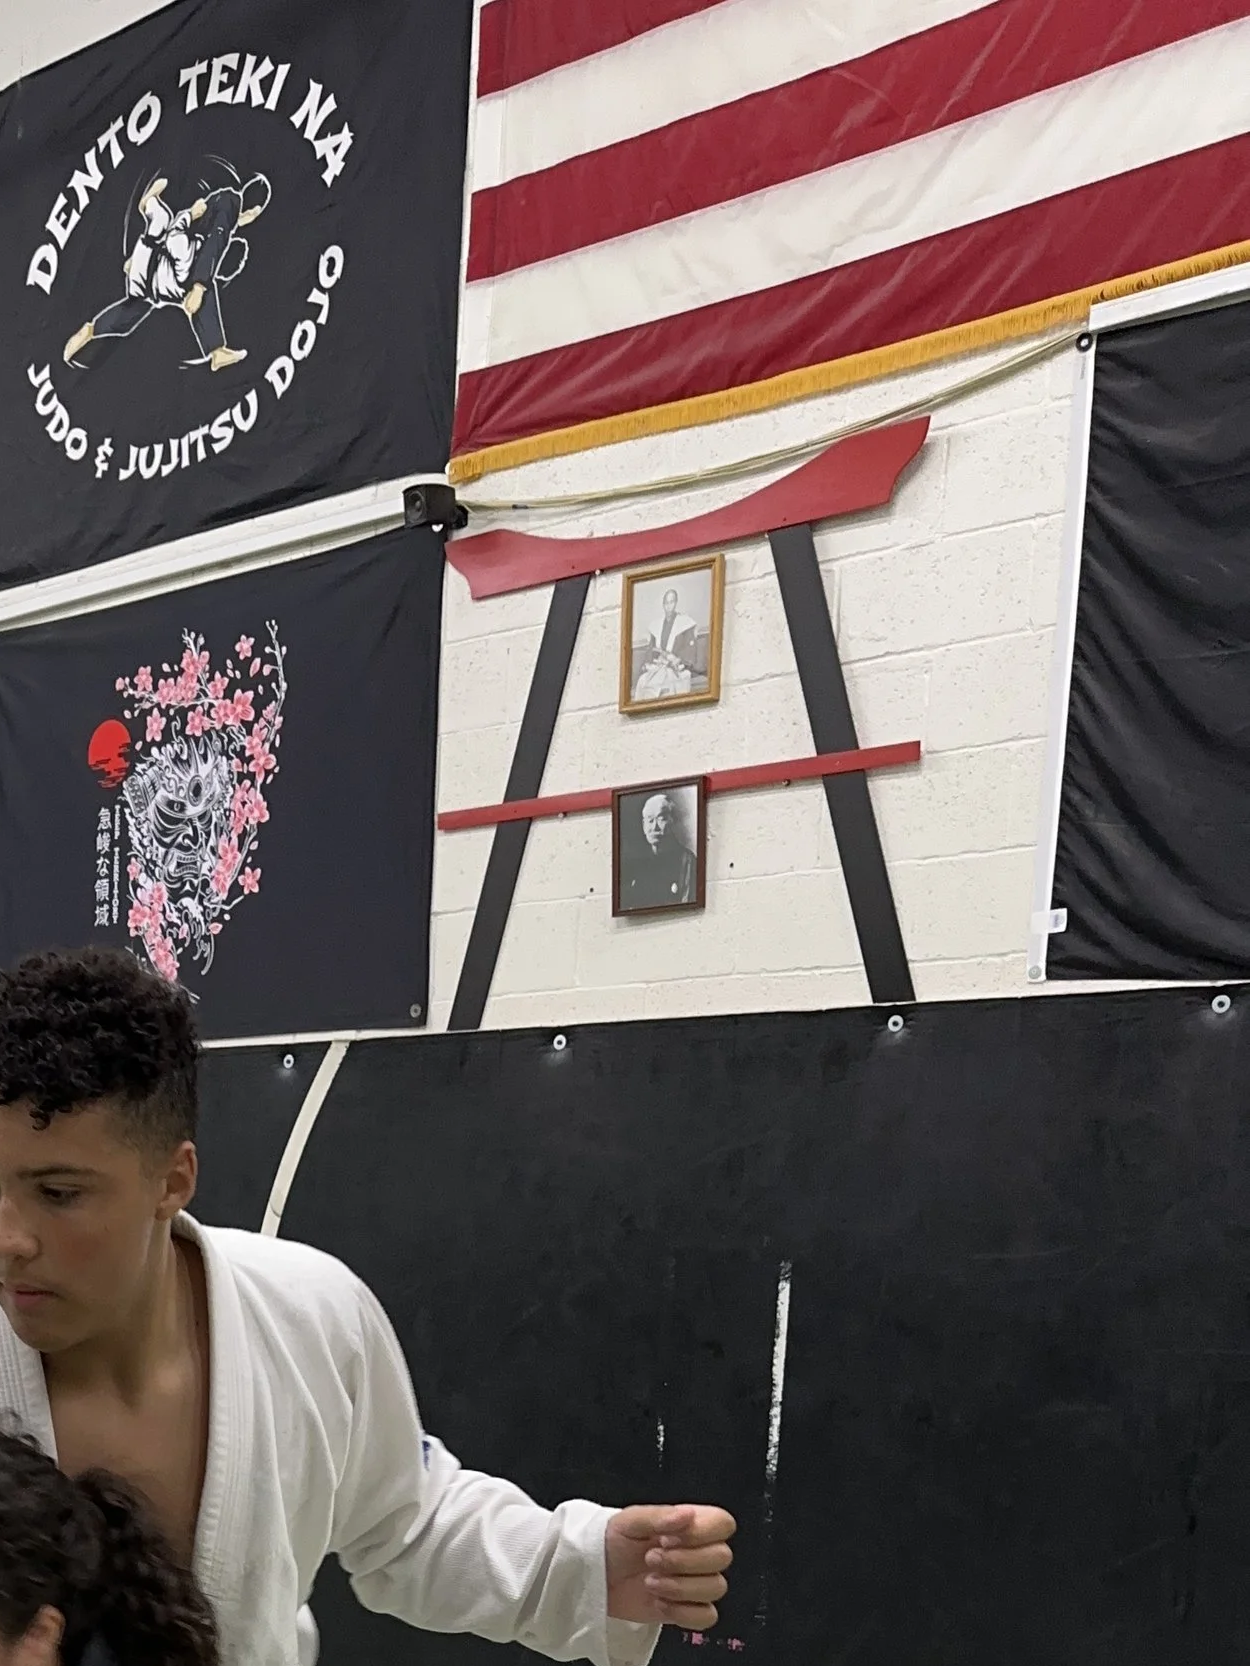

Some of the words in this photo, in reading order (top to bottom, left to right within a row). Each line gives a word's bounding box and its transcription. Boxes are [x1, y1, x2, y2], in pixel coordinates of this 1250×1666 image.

[26, 91, 162, 294] DENTO
[179, 52, 291, 114] TEKI
[290, 78, 354, 187] NA
[27, 363, 88, 461] JUDO
[119, 389, 259, 481] JUJITSU
[264, 244, 345, 399] DOJO
